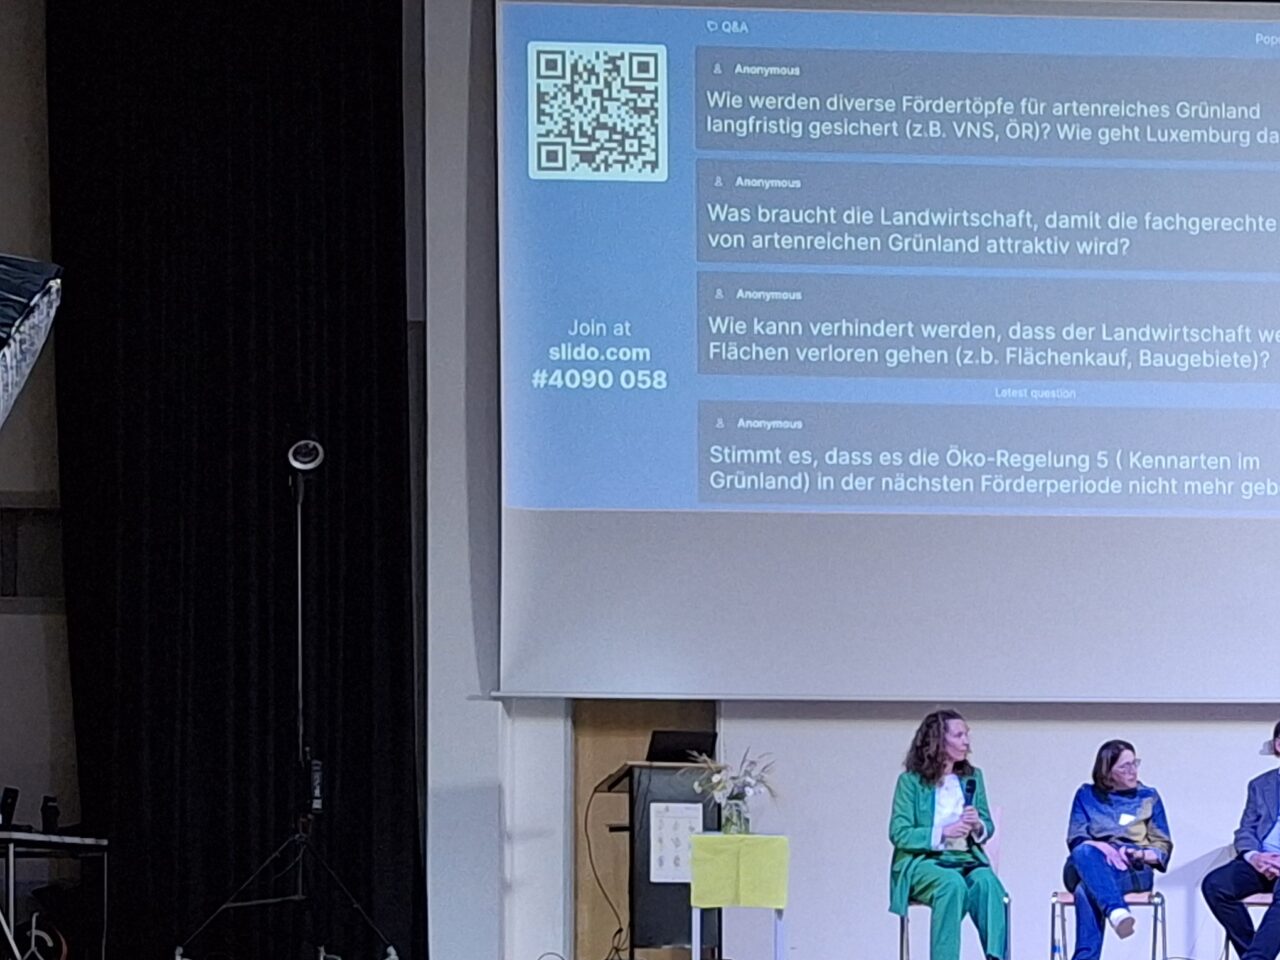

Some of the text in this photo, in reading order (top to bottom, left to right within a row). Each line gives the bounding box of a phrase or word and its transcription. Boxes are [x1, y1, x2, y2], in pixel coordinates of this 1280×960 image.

[721, 20, 749, 34] Q&A
[734, 63, 801, 77] Anonymous
[706, 90, 1261, 120] Wie werden diverse Fördertöpfe für artenreiches Grünland
[707, 115, 803, 139] langfristig
[808, 118, 899, 139] gesichert
[952, 121, 1000, 142] VNS,
[1005, 118, 1051, 141] ÖR)?
[1056, 123, 1092, 141] Wie
[1097, 124, 1141, 145] geht
[1146, 125, 1251, 147] Luxemburg
[734, 176, 802, 190] Anonymous
[707, 203, 751, 222] Was
[757, 205, 837, 224] braucht
[842, 206, 874, 225] die
[880, 207, 1039, 232] Landwirtschaft,
[1044, 210, 1102, 230] damit
[1107, 211, 1138, 230] die
[1144, 211, 1277, 235] fachgerechte
[707, 231, 1130, 256] von artenreichen Grünland attraktiv wird?
[735, 288, 803, 302] Anonymous
[567, 318, 632, 336] Join at
[708, 315, 747, 335] Wie
[753, 317, 803, 336] kann
[809, 318, 914, 338] verhindert
[920, 321, 1002, 342] werden,
[1008, 321, 1056, 340] dass
[1061, 323, 1096, 341] der
[1101, 323, 1251, 343] Landwirtschaft
[549, 342, 651, 361] slido.com
[709, 341, 1270, 372] Flächen verloren gehen (z.b. Flächenkauf, Baugebiete)?
[531, 368, 668, 390] #4090 058
[1030, 388, 1077, 400] question
[737, 417, 803, 431] Anonymous
[709, 444, 1260, 471] Stimmt es, dass es die Öko-Regelung 5 ( Kennarten im
[709, 470, 810, 493] Grünland)
[817, 472, 834, 490] in
[840, 472, 875, 491] der
[881, 472, 974, 492] nächsten
[981, 474, 1122, 497] Förderperiode
[1128, 476, 1178, 494] nicht
[1184, 478, 1234, 495] mehr
